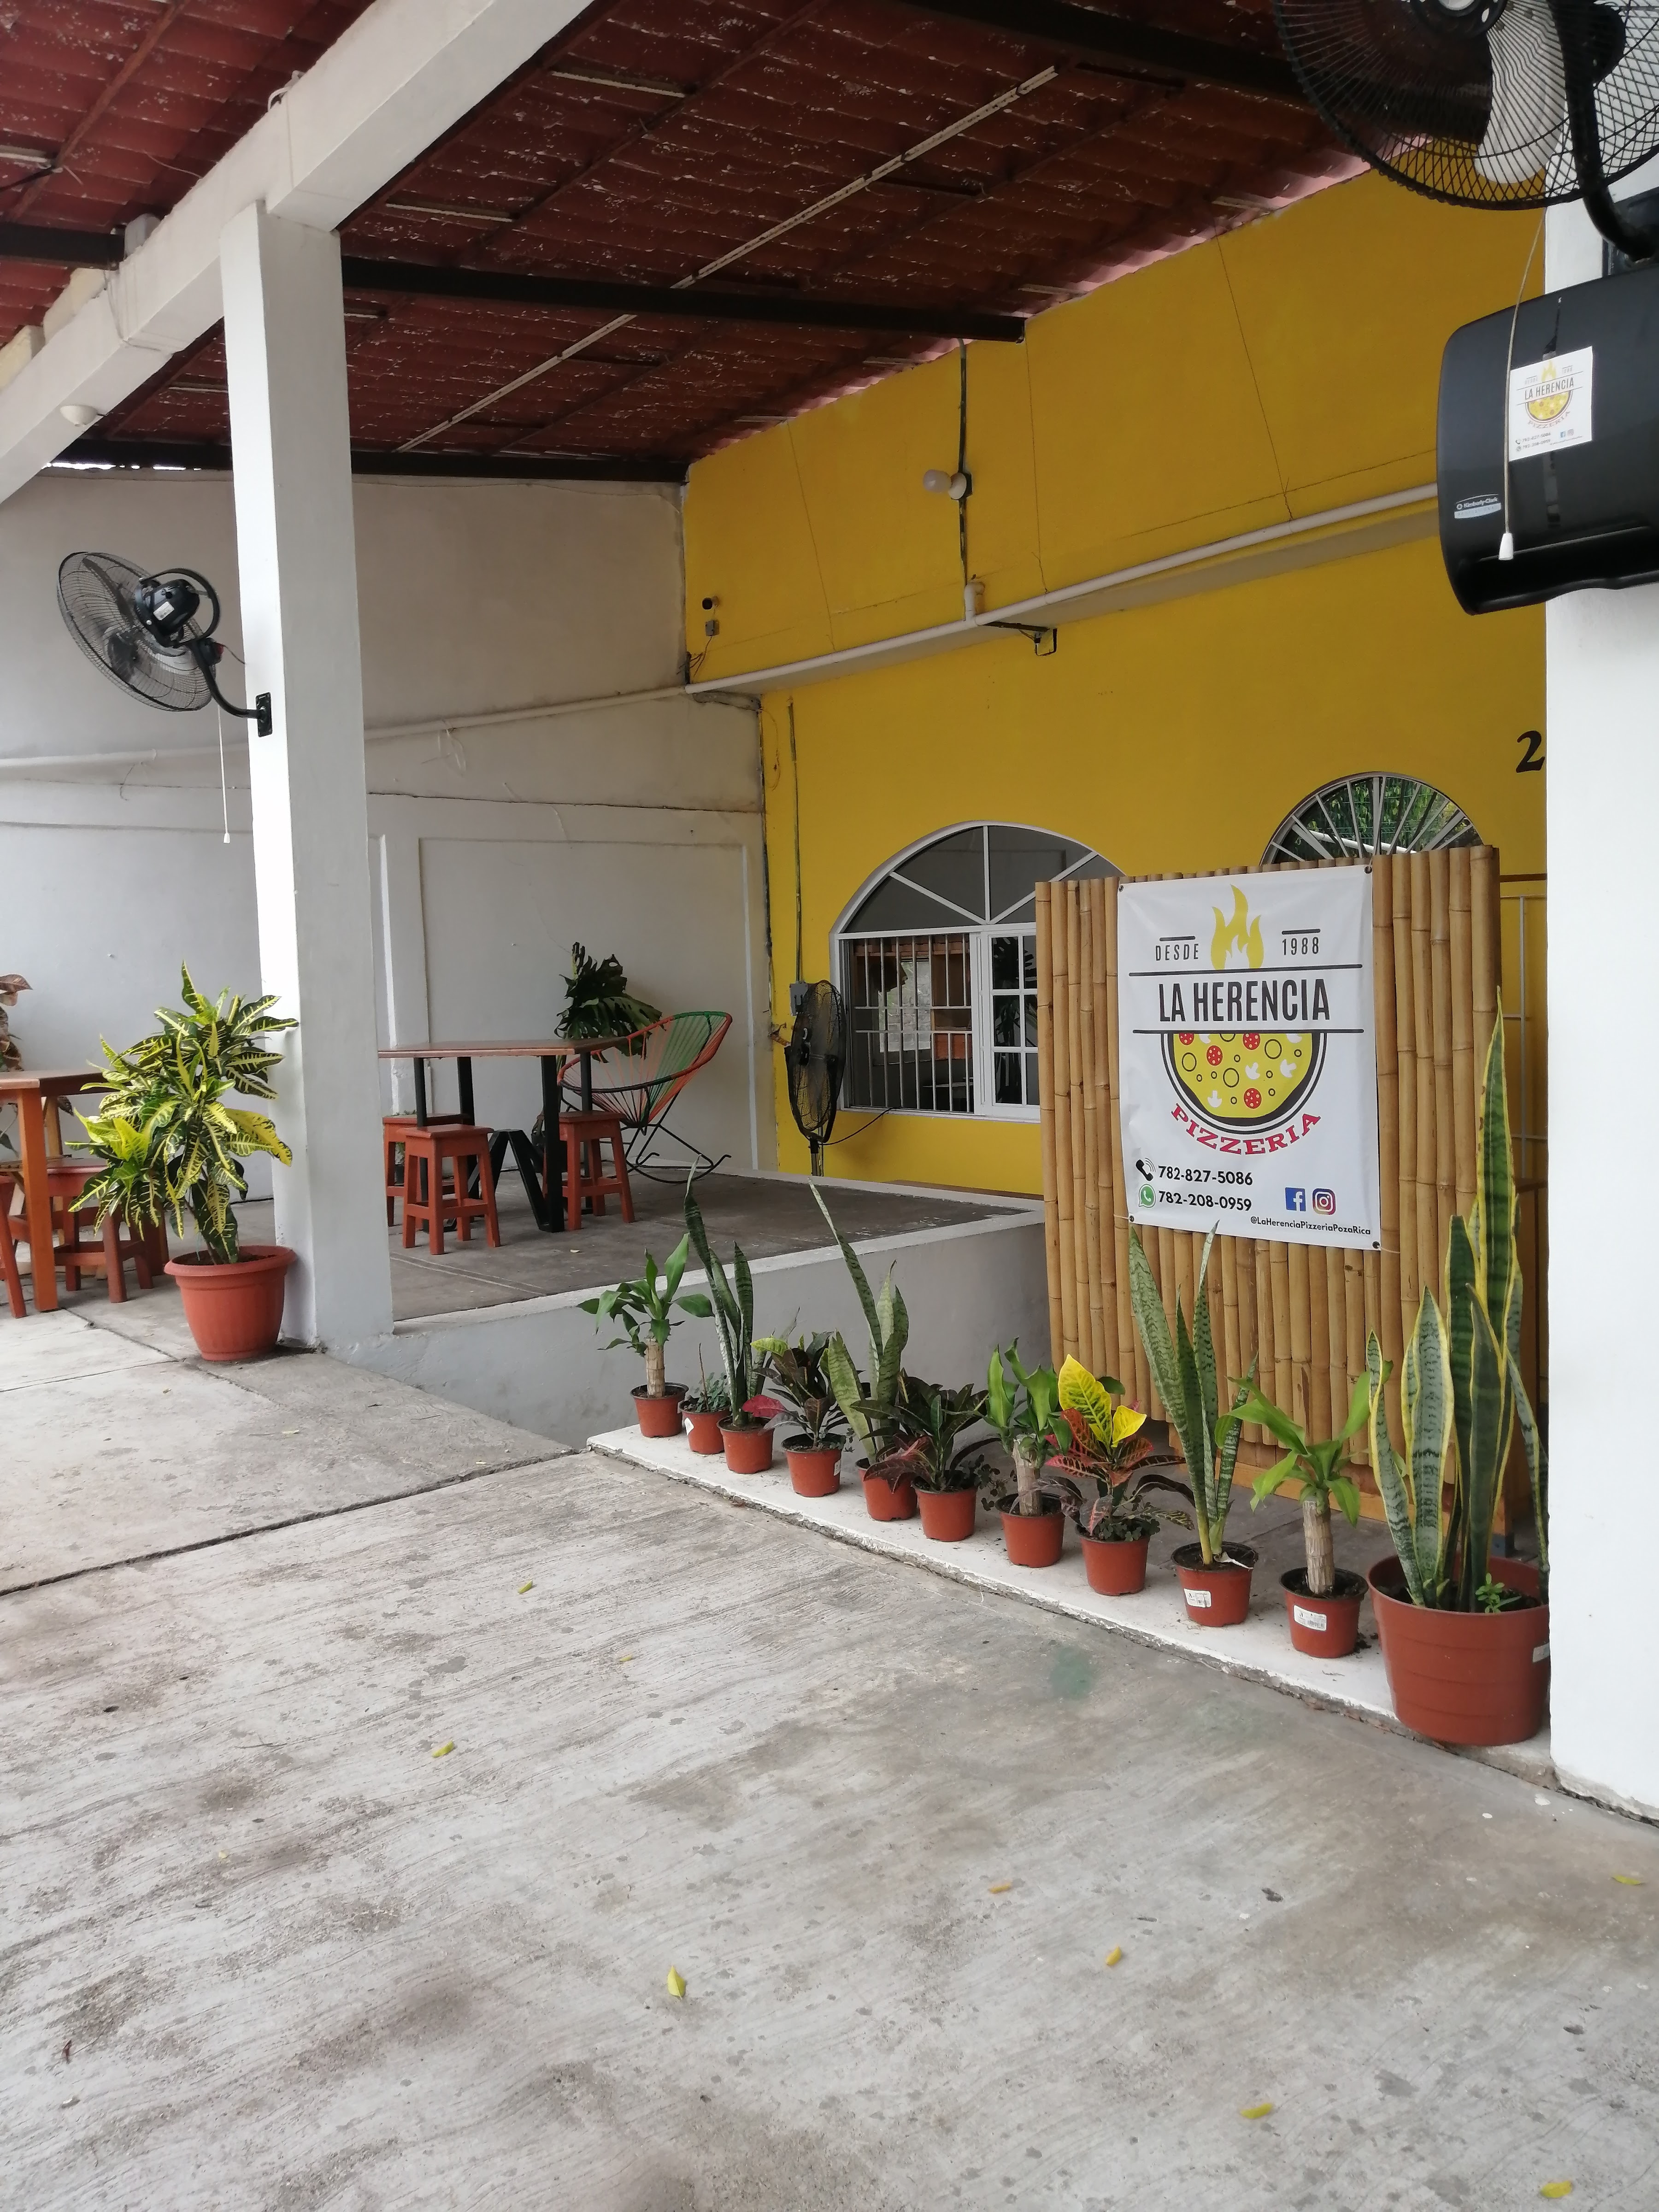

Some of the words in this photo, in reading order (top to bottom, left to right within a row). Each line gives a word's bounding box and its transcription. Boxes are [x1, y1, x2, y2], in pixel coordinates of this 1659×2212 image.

[1525, 388, 1533, 400] LA
[1536, 377, 1574, 397] HERENCIA
[1527, 412, 1571, 429] PIZZERIA
[1156, 943, 1199, 961] DESDE
[1282, 937, 1320, 955] 1988
[1159, 983, 1186, 1022] LA
[1194, 979, 1330, 1021] HERENCIA
[1171, 1103, 1321, 1155] PIZZERIA
[1159, 1165, 1253, 1186] 782-827-5086
[1159, 1191, 1252, 1212] 782-208-0959
[1251, 1216, 1371, 1235] @LaHerenciaPizzeriaPozaRica
